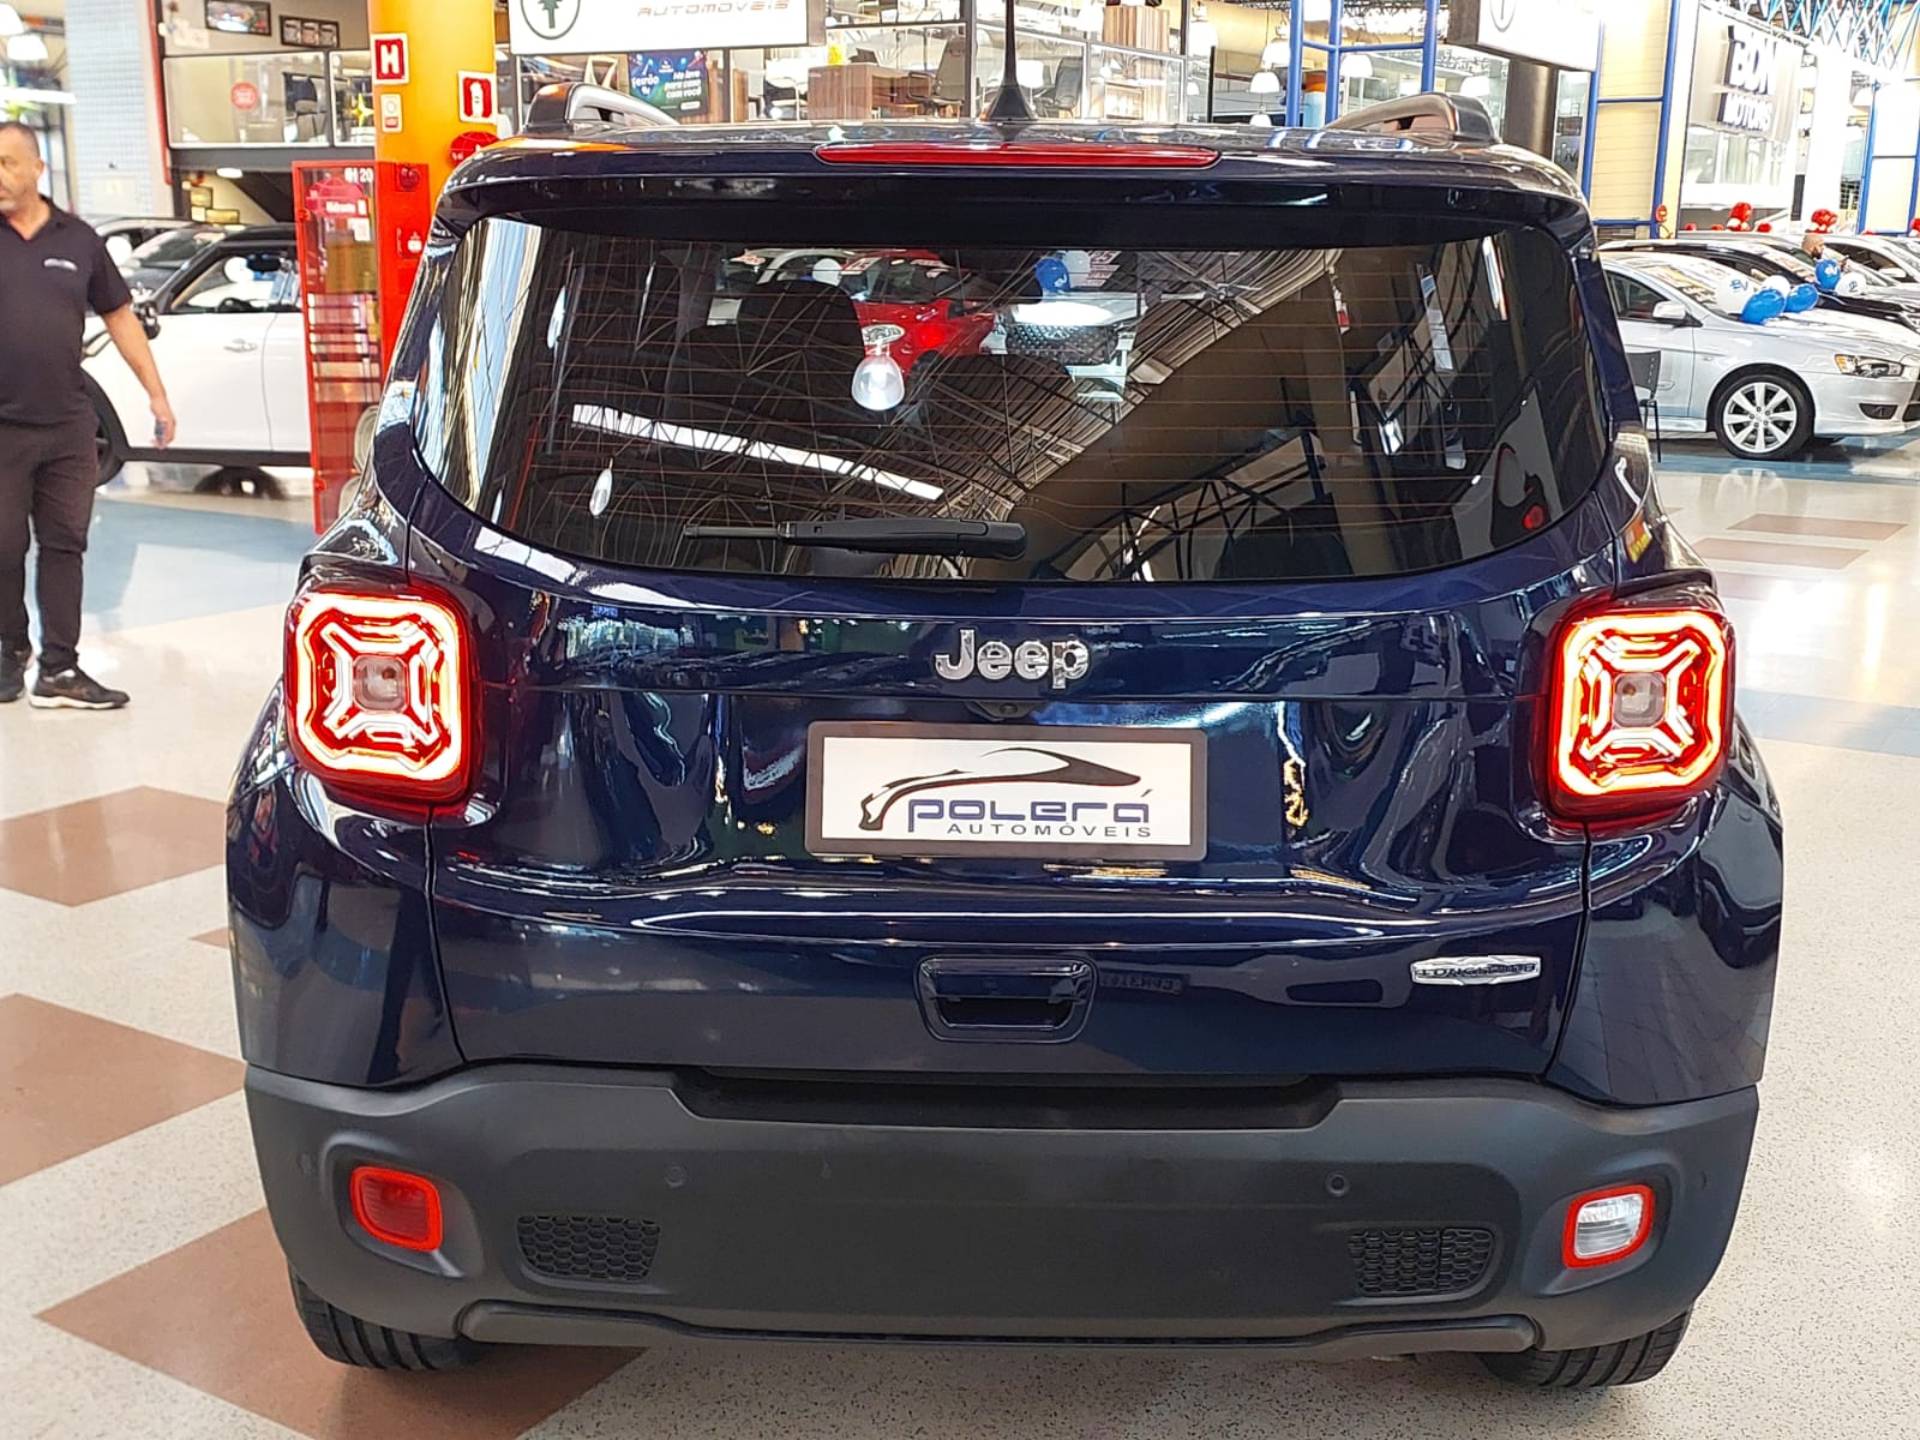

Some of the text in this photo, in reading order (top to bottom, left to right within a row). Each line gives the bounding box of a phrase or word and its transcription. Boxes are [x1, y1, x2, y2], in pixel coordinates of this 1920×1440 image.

[380, 44, 400, 74] H
[1717, 92, 1774, 132] MOTORS
[935, 629, 1089, 689] Jeep
[947, 822, 1151, 838] AUTOMÓVEIS
